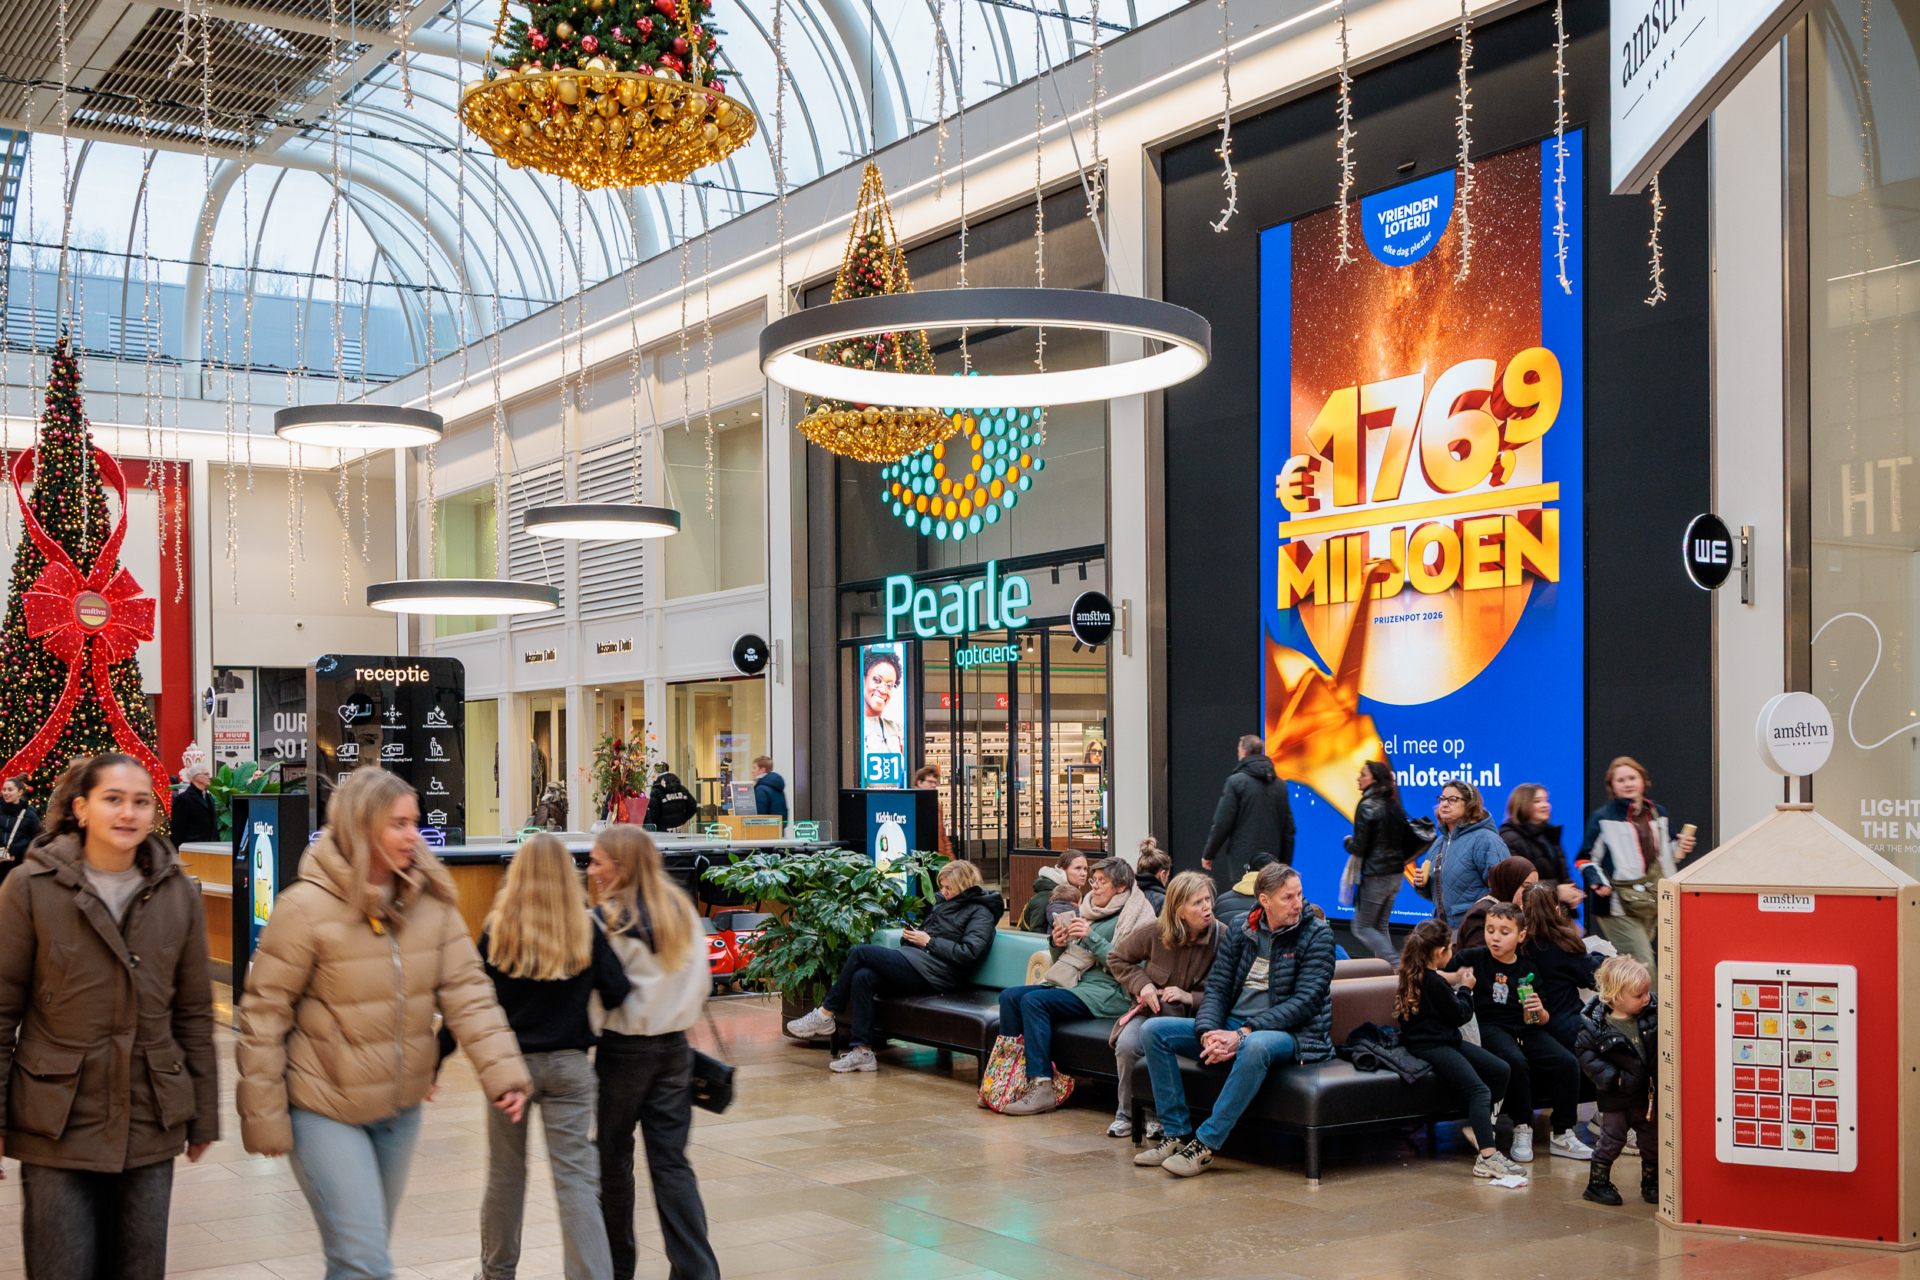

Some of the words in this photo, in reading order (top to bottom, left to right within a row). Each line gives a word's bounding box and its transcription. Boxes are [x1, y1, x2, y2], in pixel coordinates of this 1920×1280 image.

[1377, 195, 1438, 225] VRIENDEN
[1385, 212, 1430, 239] LOTERIJ
[1383, 244, 1396, 256] elke
[1396, 247, 1409, 258] dag
[1410, 231, 1432, 255] plezier
[1277, 508, 1560, 610] MILJOEN
[1695, 539, 1727, 564] WE
[886, 559, 1030, 640] Pearle
[80, 608, 106, 616] amstlvn
[1076, 610, 1111, 621] amstlvn
[1374, 613, 1420, 624] PRIJZENPOT
[1423, 611, 1443, 621] 2026
[956, 644, 1019, 671] opticiens
[355, 664, 430, 686] receptie
[273, 712, 307, 733] OUR
[1774, 722, 1828, 739] amstlvn
[273, 738, 297, 759] SO
[1403, 739, 1438, 754] mee
[1442, 738, 1465, 760] op
[869, 755, 883, 781] 3
[883, 757, 891, 780] voor
[891, 756, 899, 780] 1
[1860, 798, 1920, 817] LIGHT
[264, 822, 274, 836] Cars
[875, 811, 893, 826] Kiddy
[893, 812, 907, 824] Cars
[1861, 821, 1899, 839] THE
[1886, 845, 1903, 853] THE
[1762, 893, 1810, 905] amstlvn
